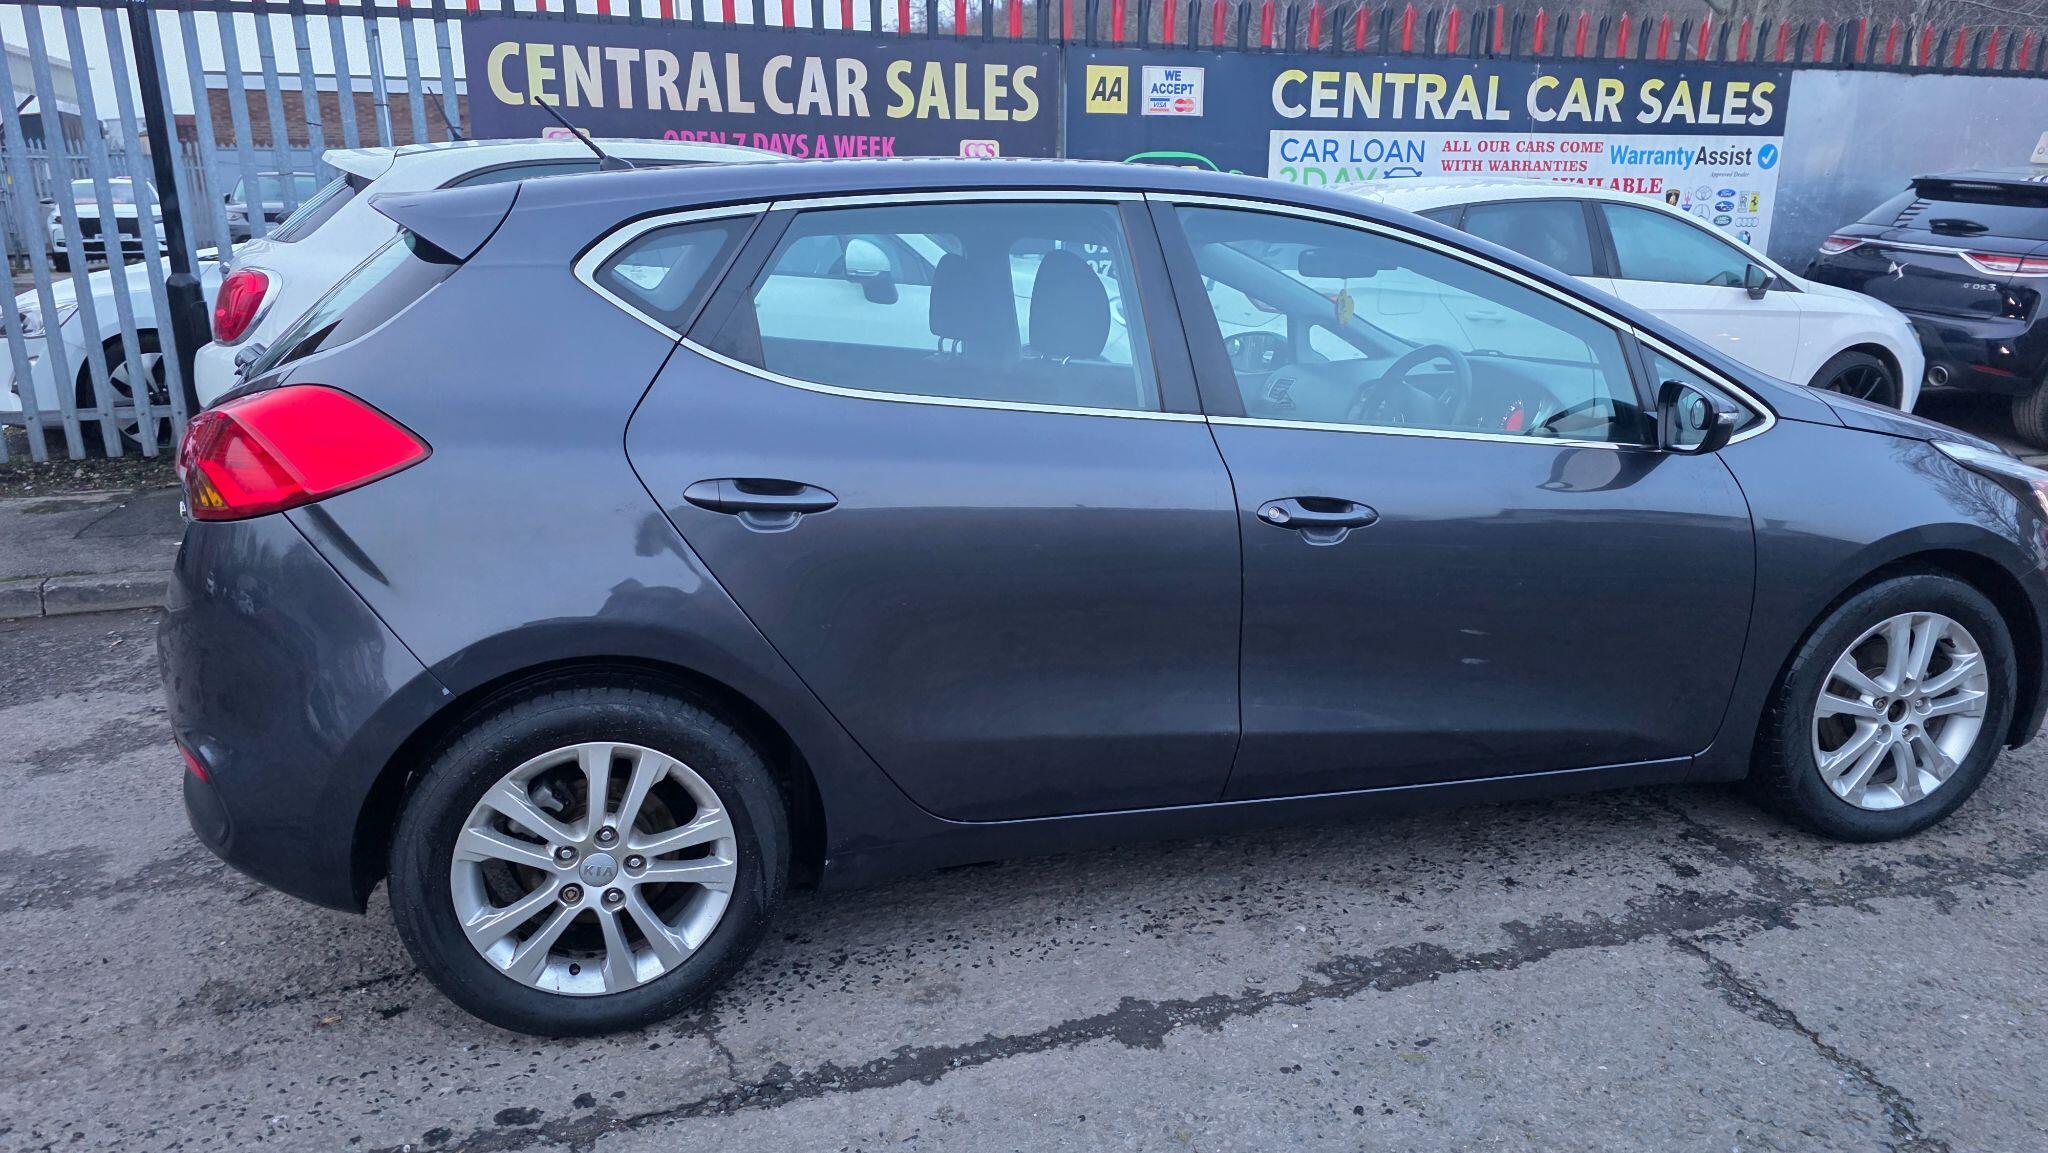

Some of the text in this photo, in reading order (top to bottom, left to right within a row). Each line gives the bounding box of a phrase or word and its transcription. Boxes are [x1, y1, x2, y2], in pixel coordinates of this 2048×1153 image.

[486, 41, 1040, 122] CENTRAL CAR SALES
[1165, 70, 1181, 81] WE
[1091, 76, 1122, 102] AA
[1151, 83, 1194, 95] ACCEPT
[1272, 69, 1775, 126] CENTRAL CAR SALES
[733, 132, 747, 147] 7
[753, 133, 808, 158] DAYS
[815, 134, 829, 158] A
[833, 135, 896, 158] WEEK
[1280, 138, 1426, 163] CAR LOAN
[1441, 140, 1604, 153] ALL OUR CARS COME
[1441, 159, 1588, 172] WITH WARRANTIES
[583, 864, 613, 876] KIA
